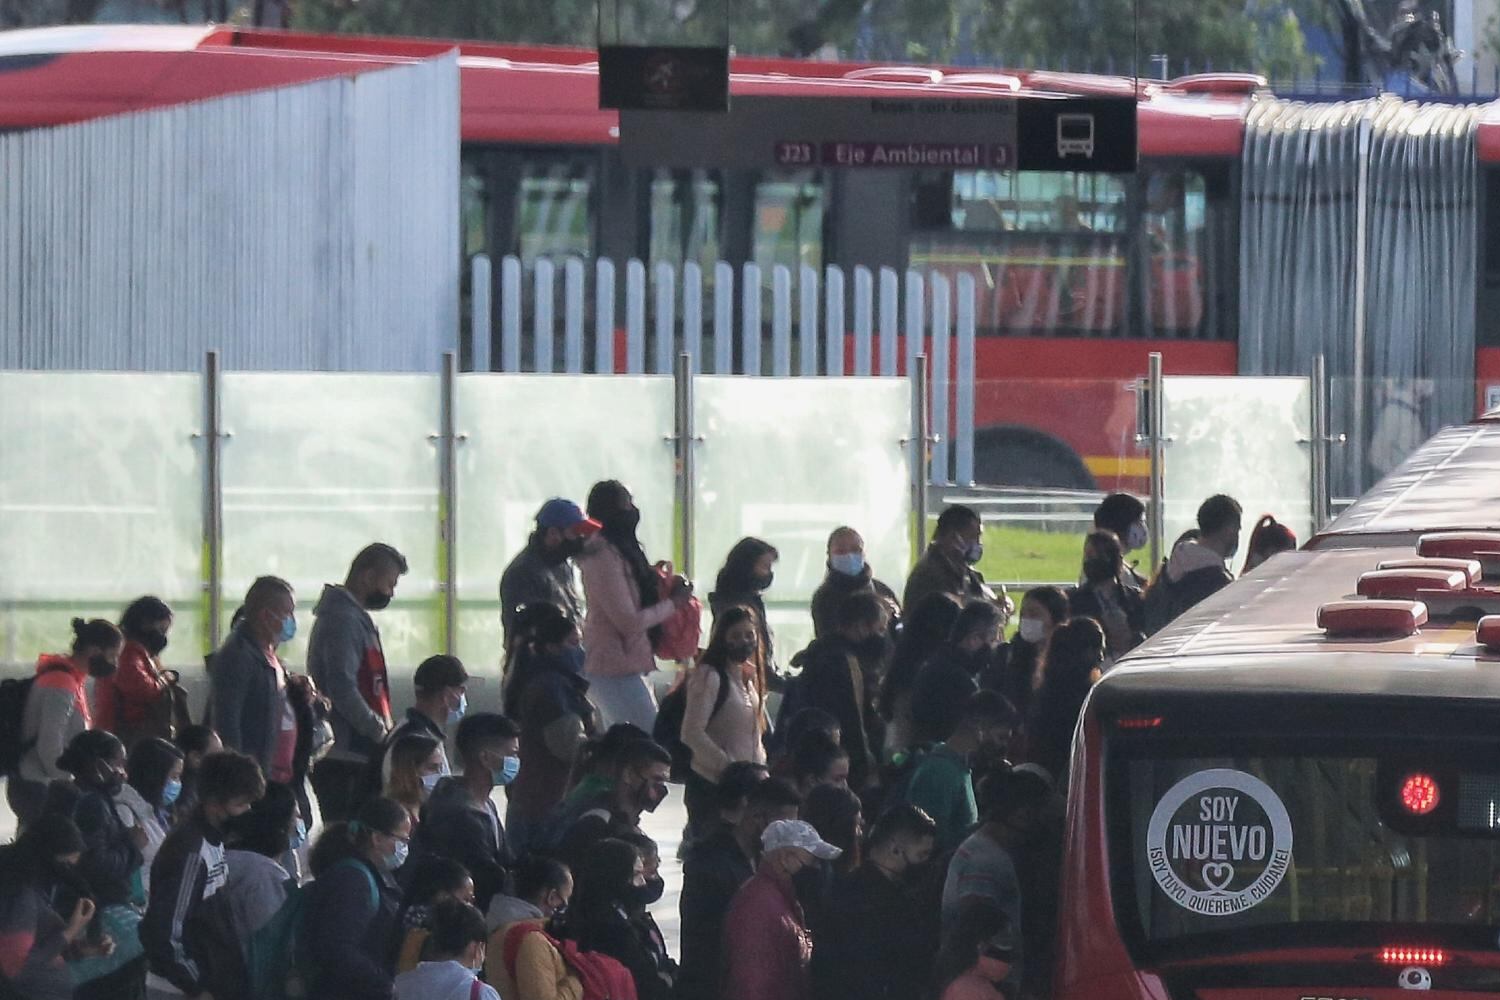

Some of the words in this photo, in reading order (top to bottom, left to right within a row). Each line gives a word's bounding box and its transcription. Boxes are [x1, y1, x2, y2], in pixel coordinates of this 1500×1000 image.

[835, 144, 865, 166] Eje
[872, 143, 979, 163] Ambiental
[1199, 796, 1239, 822] SOY
[1172, 824, 1267, 861] NUEVO
